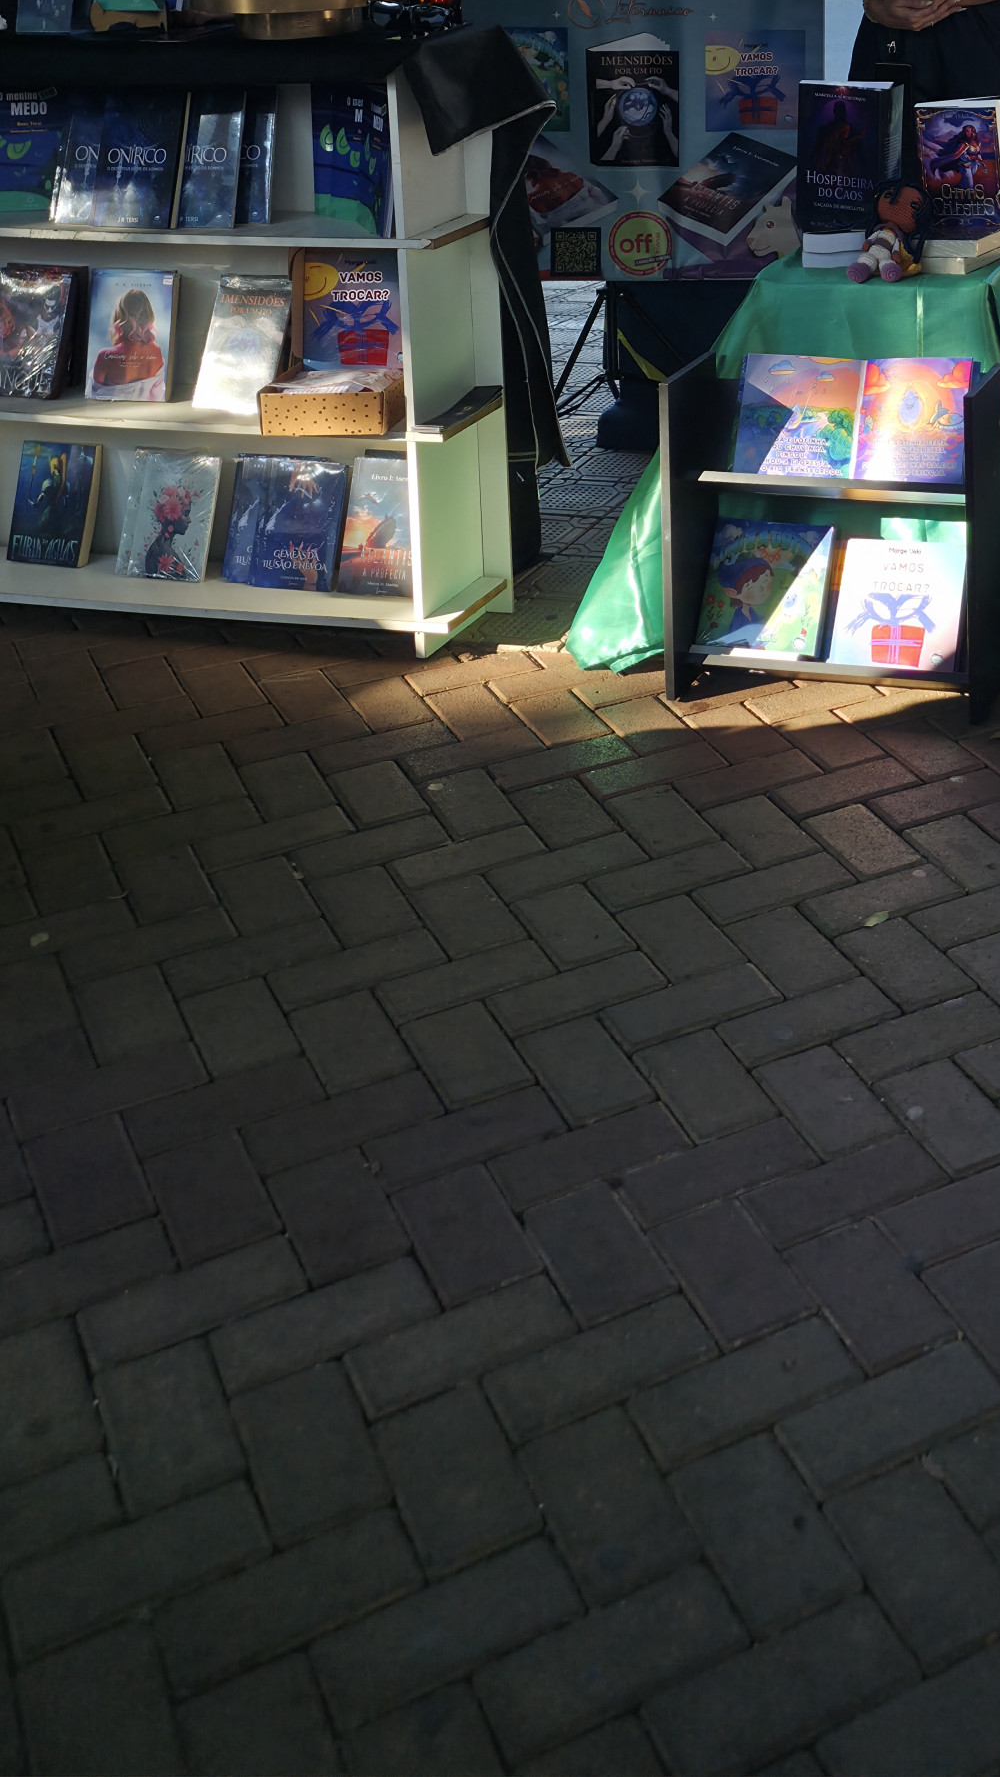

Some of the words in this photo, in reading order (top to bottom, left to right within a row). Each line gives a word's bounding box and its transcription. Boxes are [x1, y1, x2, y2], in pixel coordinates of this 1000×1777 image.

[601, 53, 674, 67] IMENSIDÕES
[740, 51, 773, 62] VAMOS
[614, 67, 631, 76] POR
[633, 67, 647, 76] UM
[734, 65, 779, 76] TROCAR?
[6, 91, 38, 101] menino
[10, 102, 48, 116] MEDO
[108, 144, 167, 166] ONÍRICO
[806, 170, 874, 190] HOSPEDEIRA
[818, 186, 832, 198] DO
[834, 187, 863, 201] CAOS
[619, 233, 653, 254] off
[339, 271, 382, 283] VAMOS
[220, 294, 286, 308] IMENSIDÕES
[331, 289, 390, 302] TROCAR?
[371, 473, 388, 481] Livro
[888, 547, 908, 555] Marge
[883, 562, 925, 573] VAMOS
[370, 568, 406, 581] PROFECIA
[873, 580, 930, 593] TROCAR?
